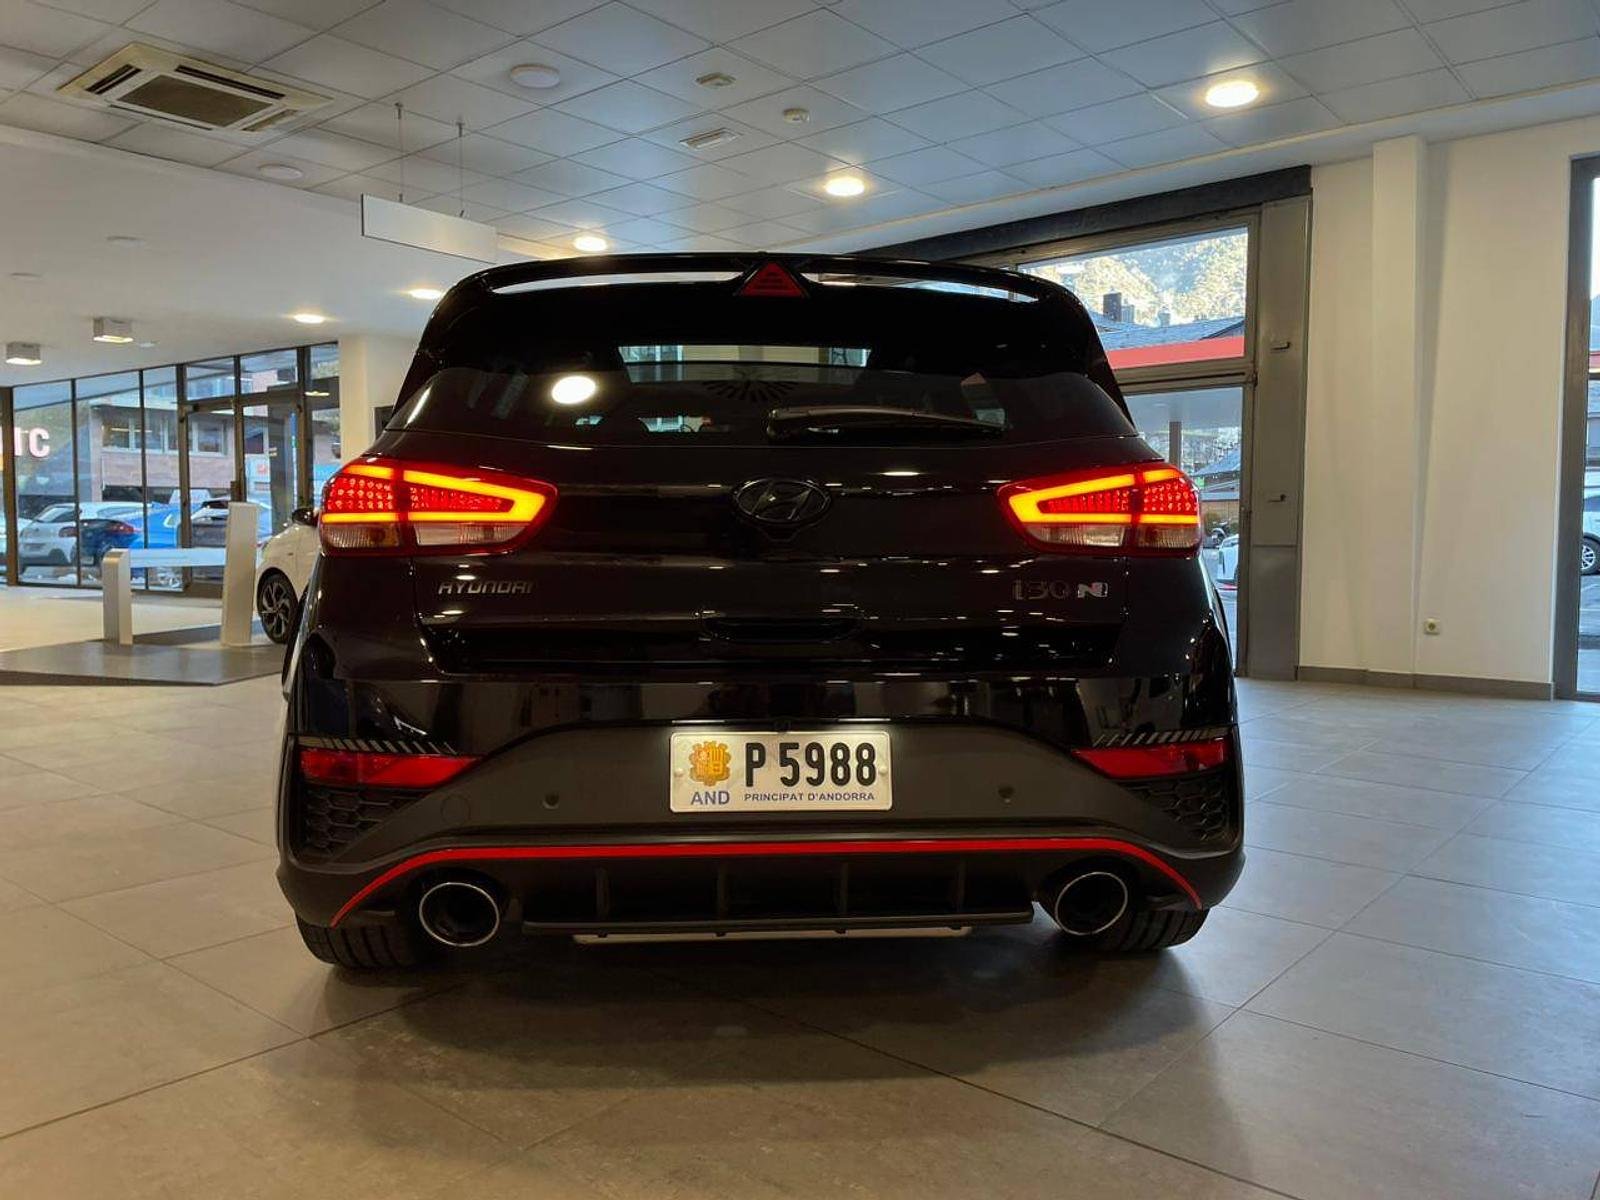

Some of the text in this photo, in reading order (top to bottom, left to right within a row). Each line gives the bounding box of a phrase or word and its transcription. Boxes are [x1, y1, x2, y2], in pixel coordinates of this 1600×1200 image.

[0, 427, 50, 458] IC
[438, 581, 534, 594] HYUNDAI
[745, 742, 876, 787] P 5988
[690, 790, 730, 805] AND
[744, 792, 875, 801] PRINCIPAT D'ANDORRA
